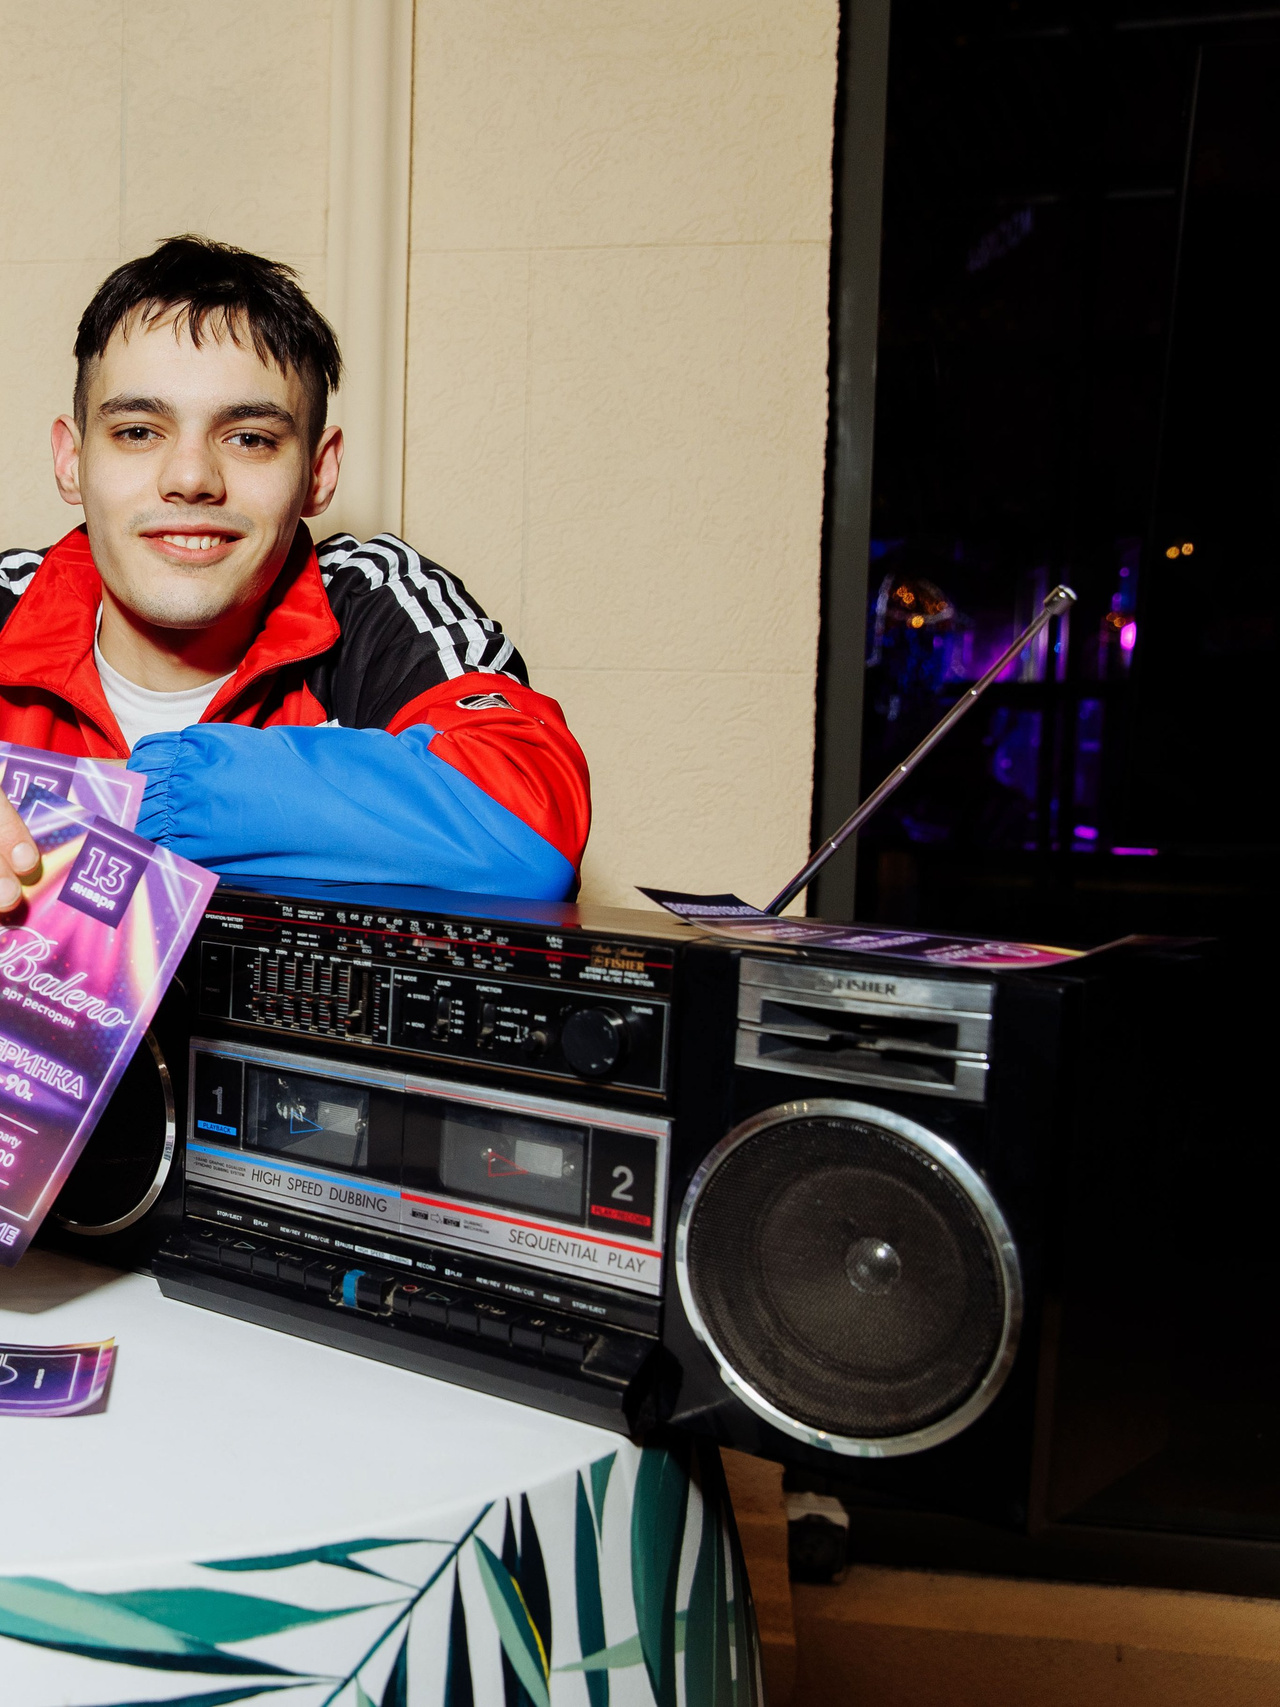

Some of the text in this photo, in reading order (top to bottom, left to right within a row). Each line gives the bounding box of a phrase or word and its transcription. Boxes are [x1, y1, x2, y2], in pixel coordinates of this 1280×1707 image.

[76, 847, 132, 894] 13
[70, 881, 116, 911] января
[604, 957, 645, 972] FISHER
[837, 978, 897, 996] FISHER
[2, 985, 77, 1029] арт ресторан
[211, 1086, 224, 1116] 1
[202, 1122, 232, 1134] PLAYBACK
[251, 1168, 388, 1212] HIGH SPEED DUBBING
[611, 1165, 634, 1202] 2
[508, 1228, 646, 1273] SEQUENTIAL PLAY
[416, 1261, 436, 1272] RECORD
[572, 1300, 606, 1315] STOP/EJECT
